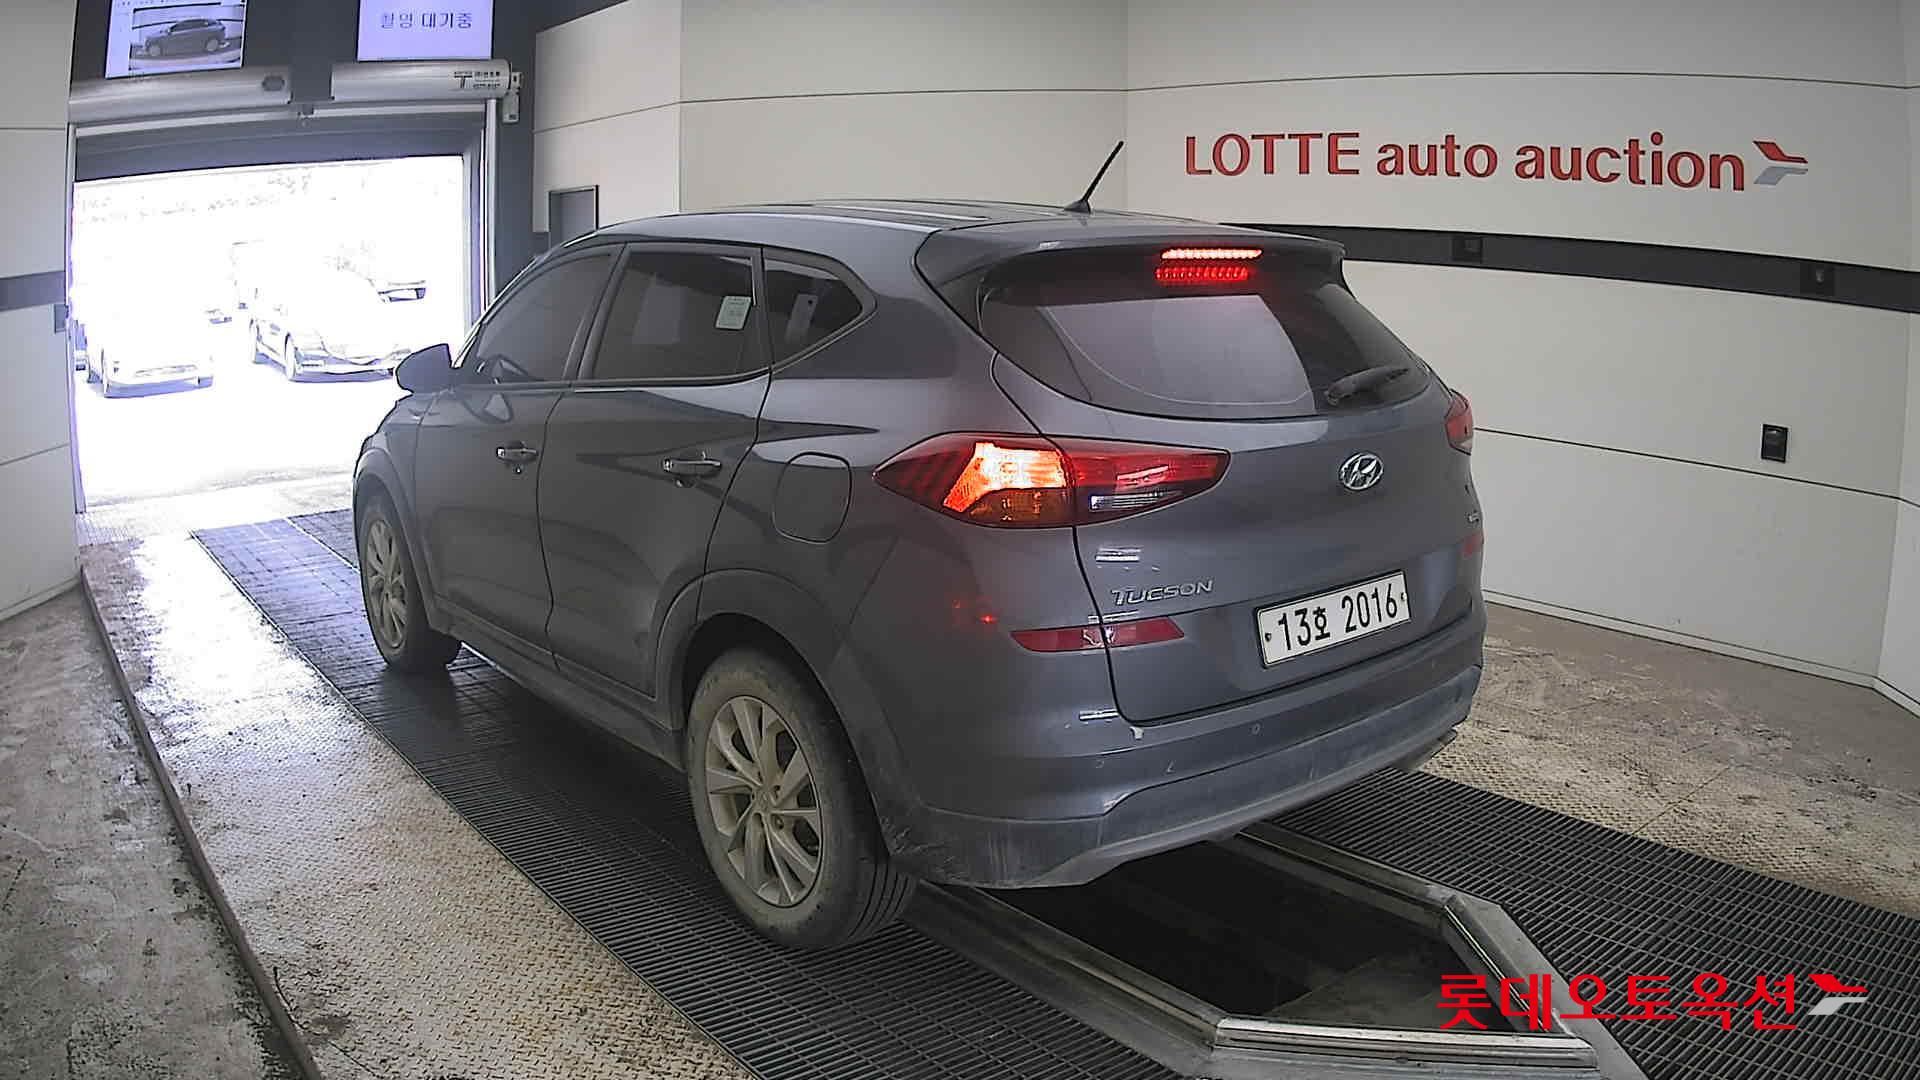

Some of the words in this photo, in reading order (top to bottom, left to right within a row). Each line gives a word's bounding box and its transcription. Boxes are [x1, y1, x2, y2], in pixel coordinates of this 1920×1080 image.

[422, 12, 472, 28] 대기중
[1185, 132, 1360, 176] LOTTE
[1377, 134, 1499, 178] auto
[1515, 132, 1746, 191] auction
[1111, 581, 1214, 606] TUCSON
[1278, 605, 1331, 650] 13호
[1341, 584, 1398, 633] 2016
